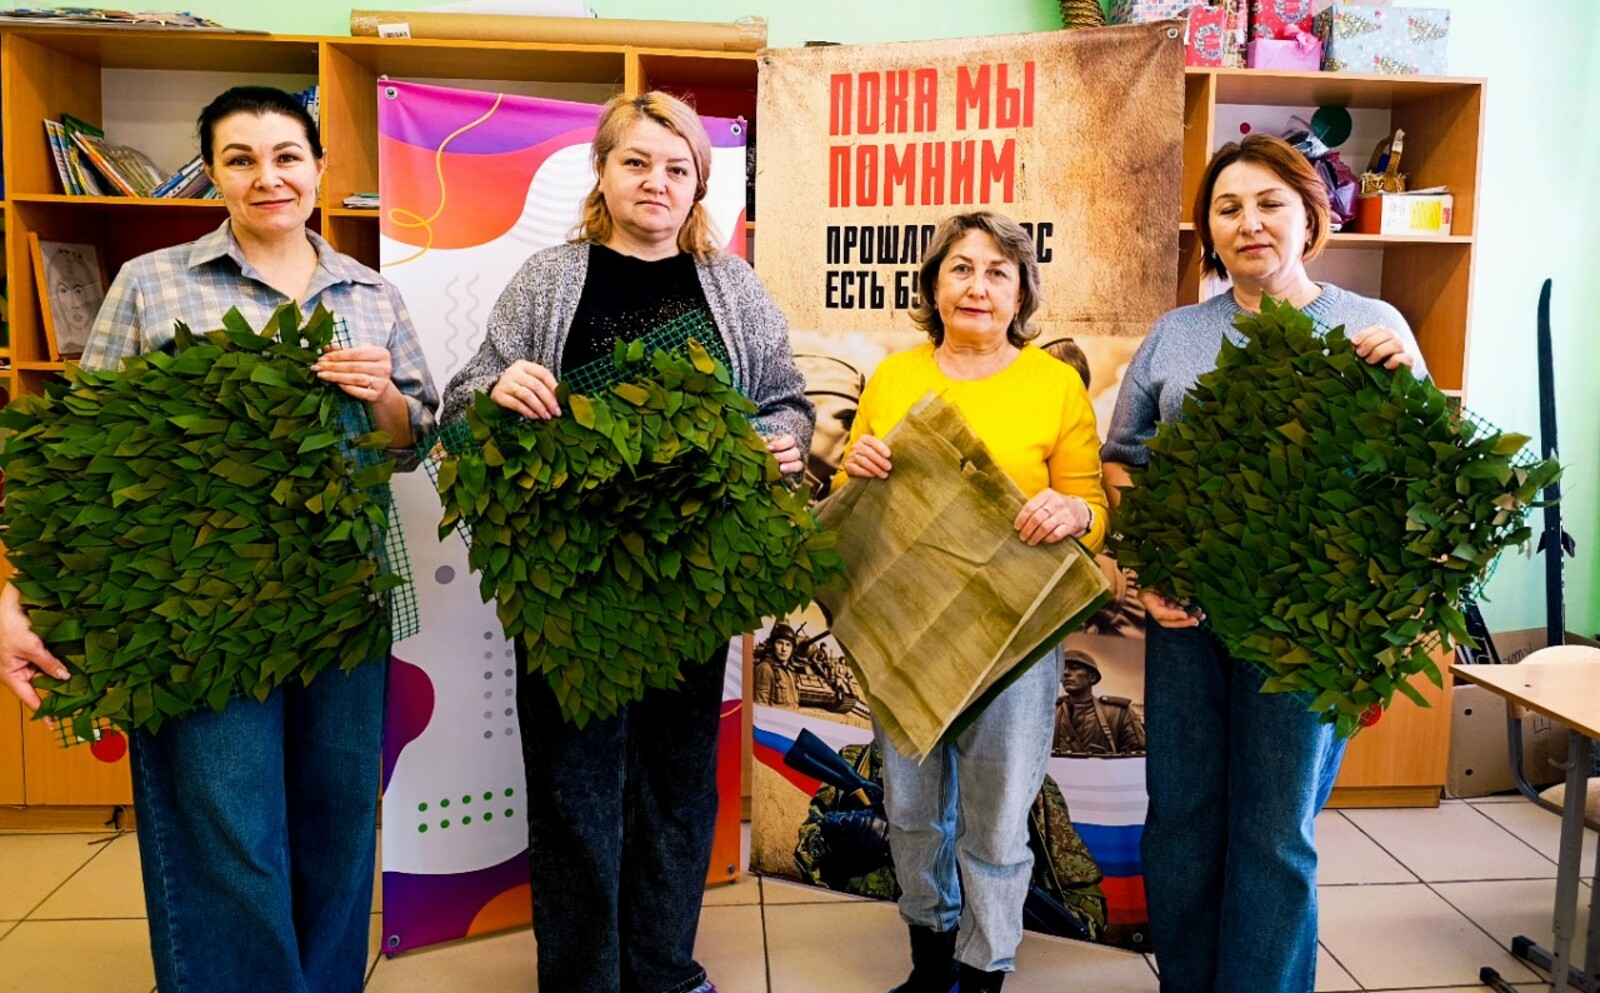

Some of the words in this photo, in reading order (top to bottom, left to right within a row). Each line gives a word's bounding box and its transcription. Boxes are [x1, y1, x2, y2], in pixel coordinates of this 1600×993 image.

[829, 68, 938, 136] ПОКА
[956, 61, 1035, 131] МЫ
[829, 138, 1016, 208] ПОМНИМ
[825, 270, 885, 309] ЕСТЬ
